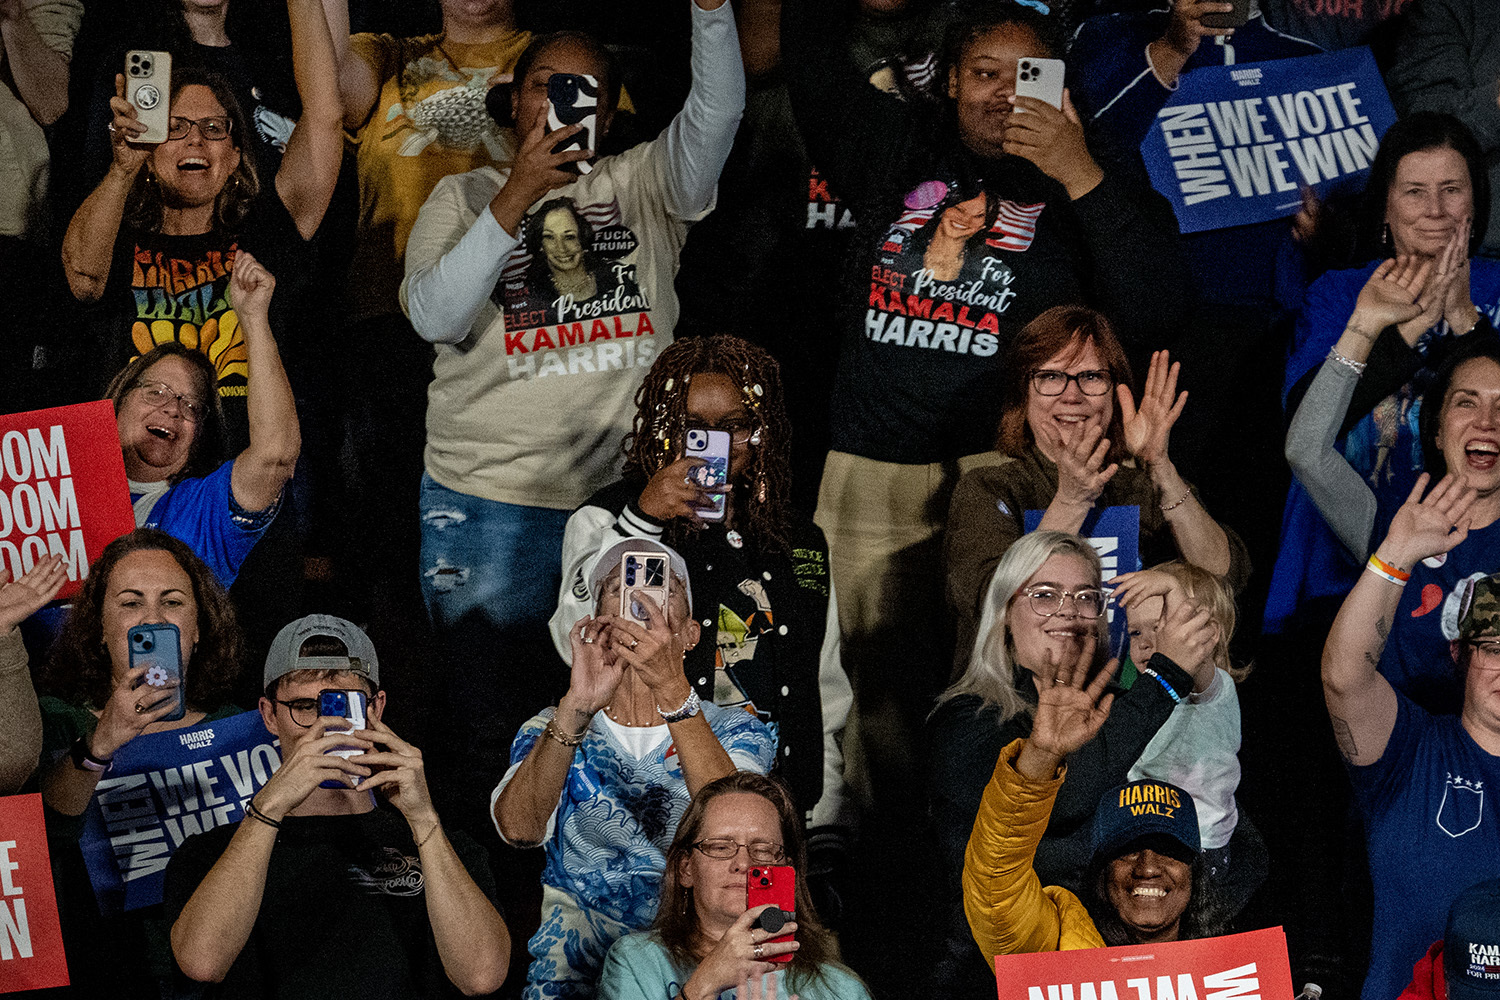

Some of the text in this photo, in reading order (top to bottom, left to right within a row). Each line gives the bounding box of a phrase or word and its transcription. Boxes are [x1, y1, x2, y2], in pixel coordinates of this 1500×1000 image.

[1230, 68, 1263, 81] HARRIS
[1205, 82, 1369, 147] WE VOTE
[1157, 103, 1231, 205] WHEN
[1220, 123, 1380, 198] WE WIN
[591, 241, 636, 252] TRUMP
[594, 230, 633, 241] FUCK
[871, 256, 1017, 288] ELECT For
[912, 267, 1017, 313] President
[132, 284, 234, 326] WAL
[504, 310, 548, 328] ELECT
[551, 285, 651, 323] President
[869, 282, 1000, 335] KAMALA
[504, 312, 655, 356] KAMALA
[865, 309, 1000, 357] HARRIS
[507, 338, 656, 378] HARRIS
[179, 728, 215, 746] HARRIS
[187, 739, 213, 750] WALZ
[149, 739, 283, 817] WE VO
[1119, 784, 1181, 809] HARRIS
[95, 773, 171, 882] WHEN
[1130, 803, 1175, 819] WALZ
[1466, 969, 1483, 979] FOR
